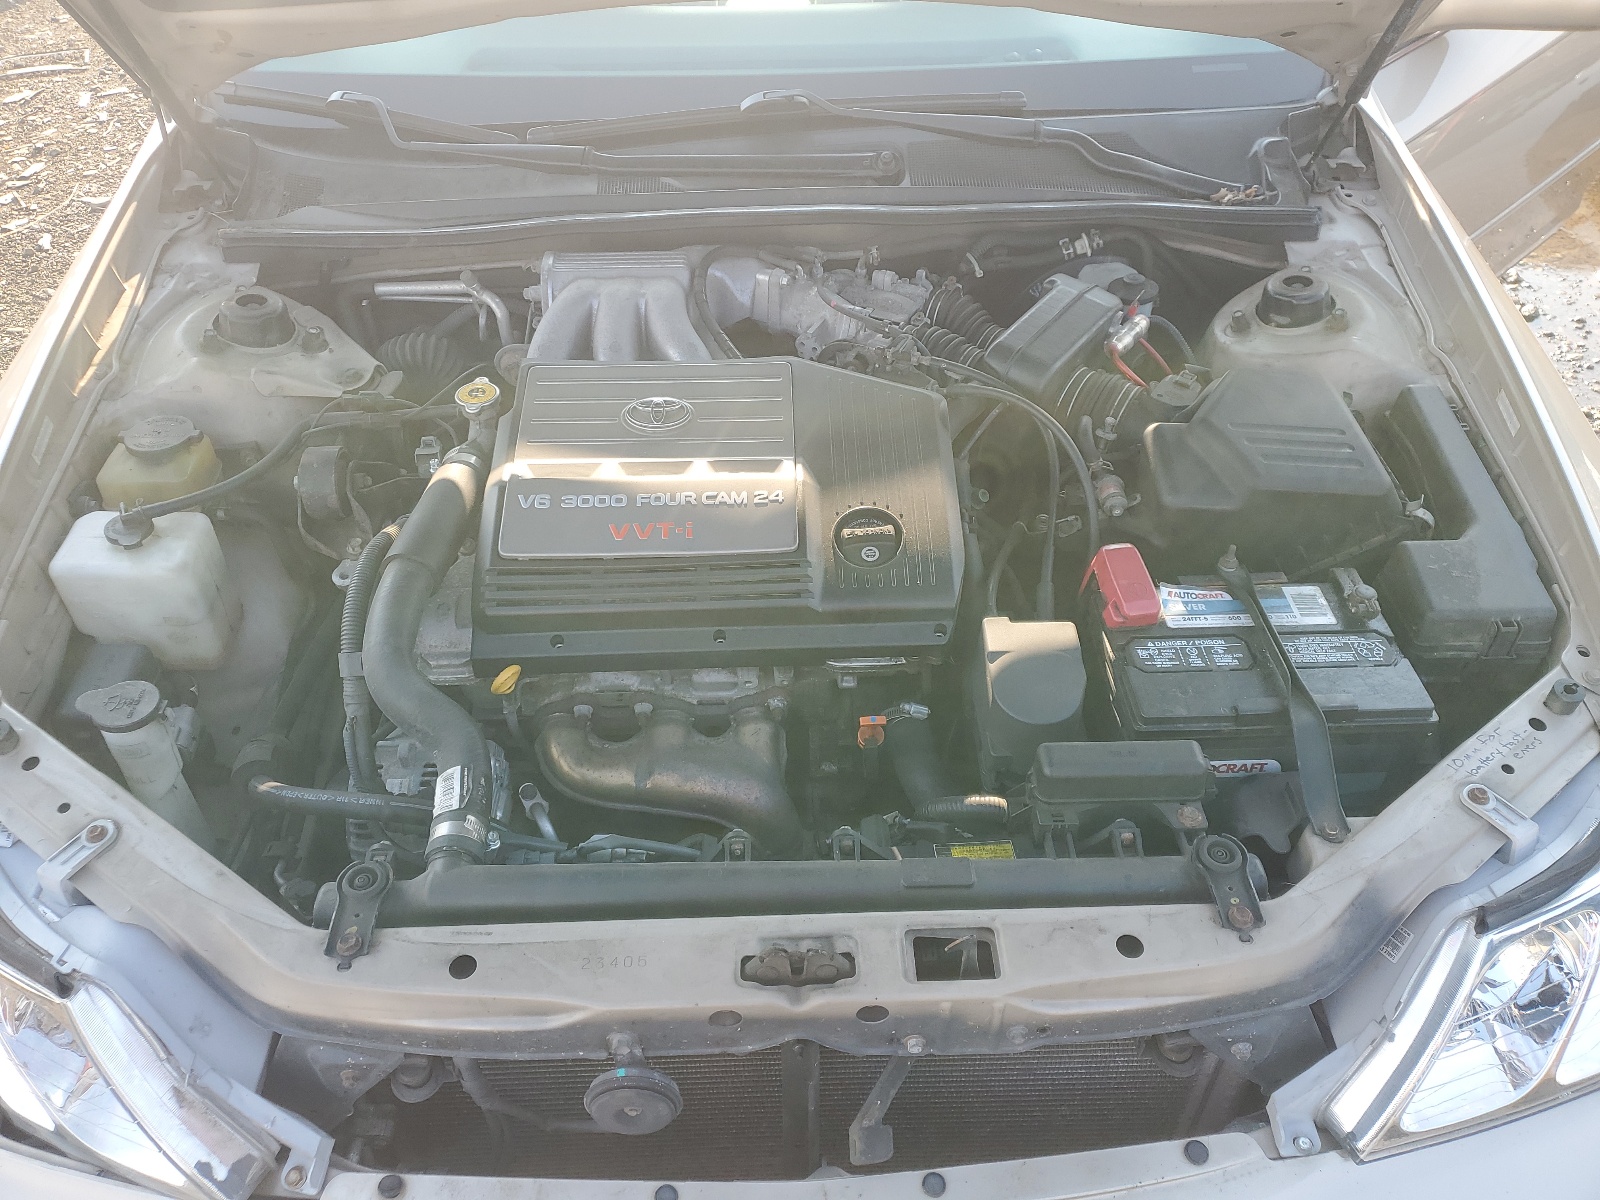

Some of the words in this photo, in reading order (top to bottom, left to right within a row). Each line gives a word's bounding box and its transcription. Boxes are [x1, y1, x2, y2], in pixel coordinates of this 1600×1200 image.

[518, 494, 551, 509] V6
[560, 494, 628, 509] 3000
[636, 491, 697, 507] FOUR
[701, 490, 748, 506] CAM
[753, 490, 785, 506] 24
[608, 521, 694, 541] VVT-i
[1174, 591, 1224, 600] AUTOCRAFT
[1195, 639, 1226, 647] POISON
[1466, 748, 1506, 777] battery
